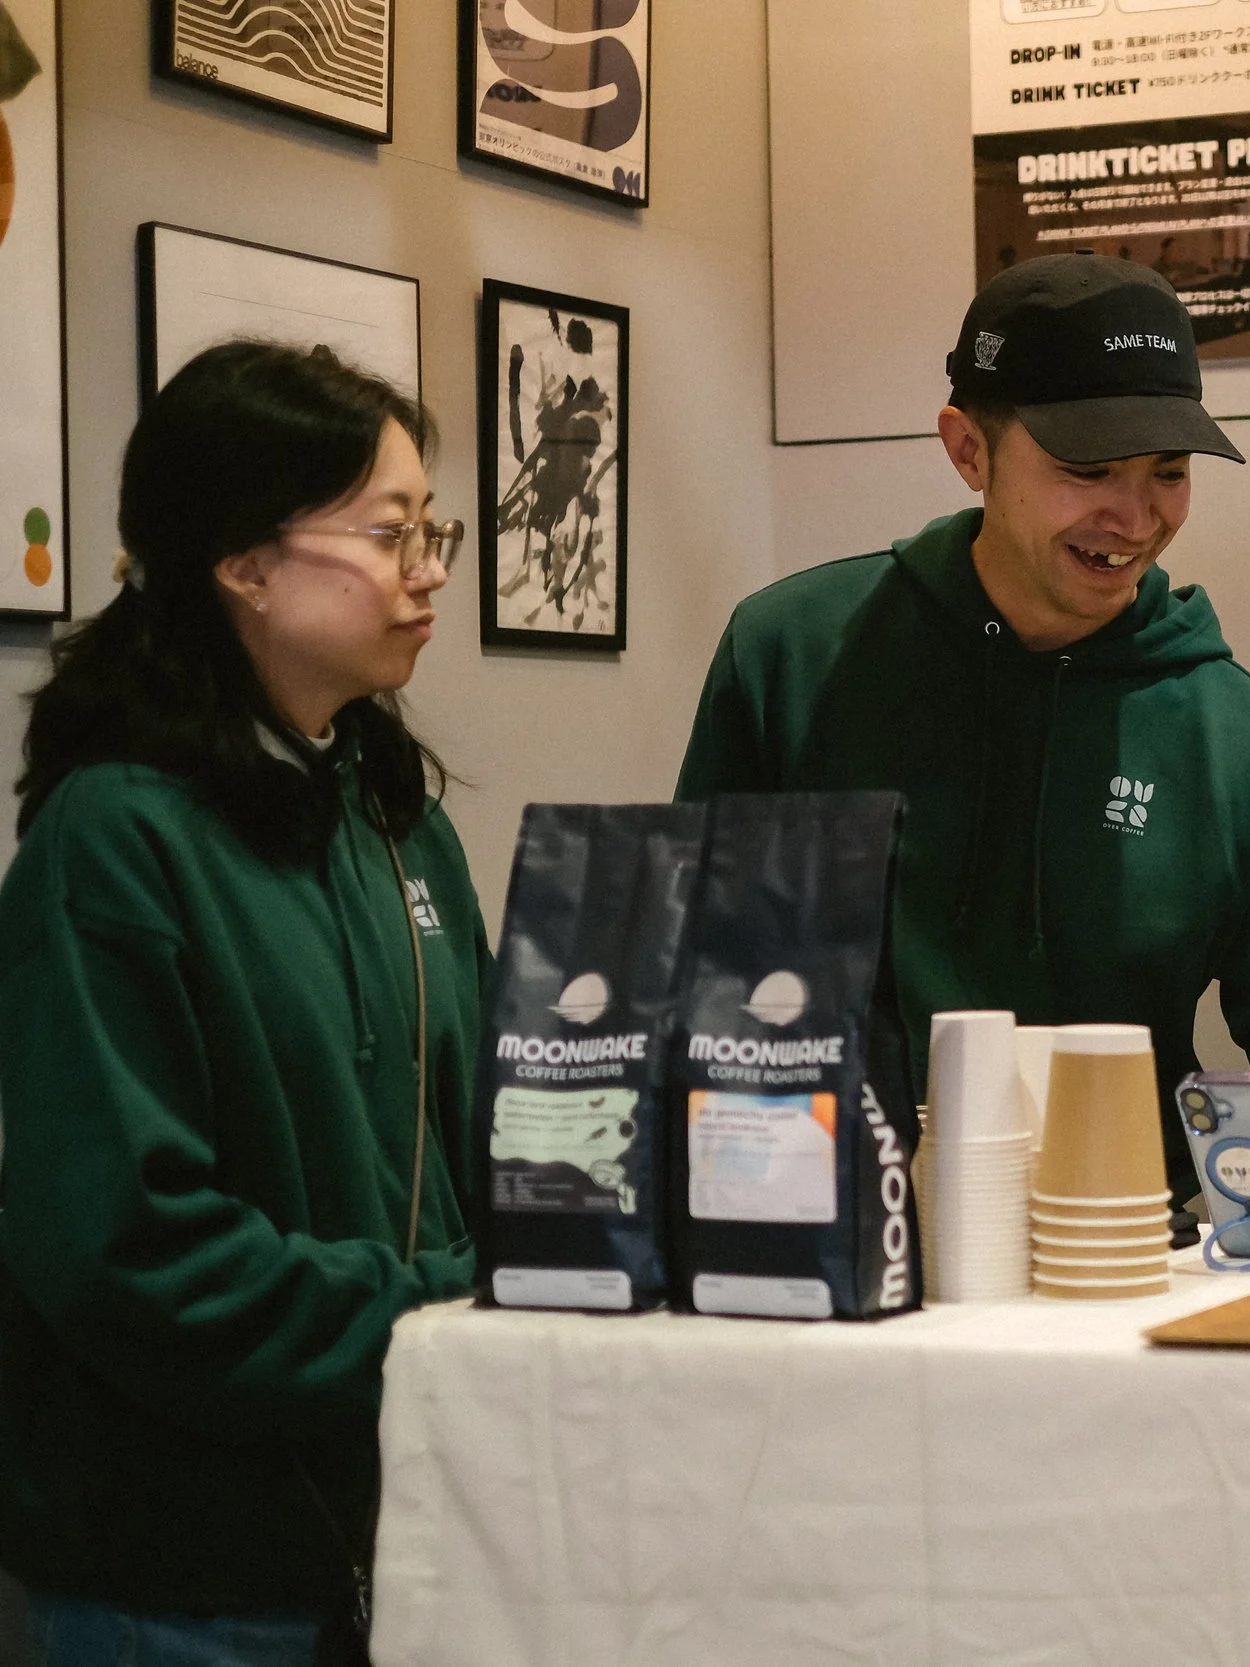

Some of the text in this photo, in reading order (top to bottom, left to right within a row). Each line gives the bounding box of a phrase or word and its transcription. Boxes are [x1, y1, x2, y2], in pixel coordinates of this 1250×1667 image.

[176, 48, 219, 79] balance
[1010, 43, 1081, 65] DROP-IN
[1011, 78, 1141, 105] DRINK TICKET
[1017, 140, 1218, 184] DRINKTICKET
[1103, 334, 1177, 353] SAME TEAM
[1121, 826, 1144, 836] COFFEE
[495, 1033, 649, 1065] MOONWAKE
[688, 1033, 845, 1068] MOONWAKE
[515, 1062, 625, 1081] COFFEE ROASTERS
[707, 1064, 822, 1084] COFFEE ROASTERS
